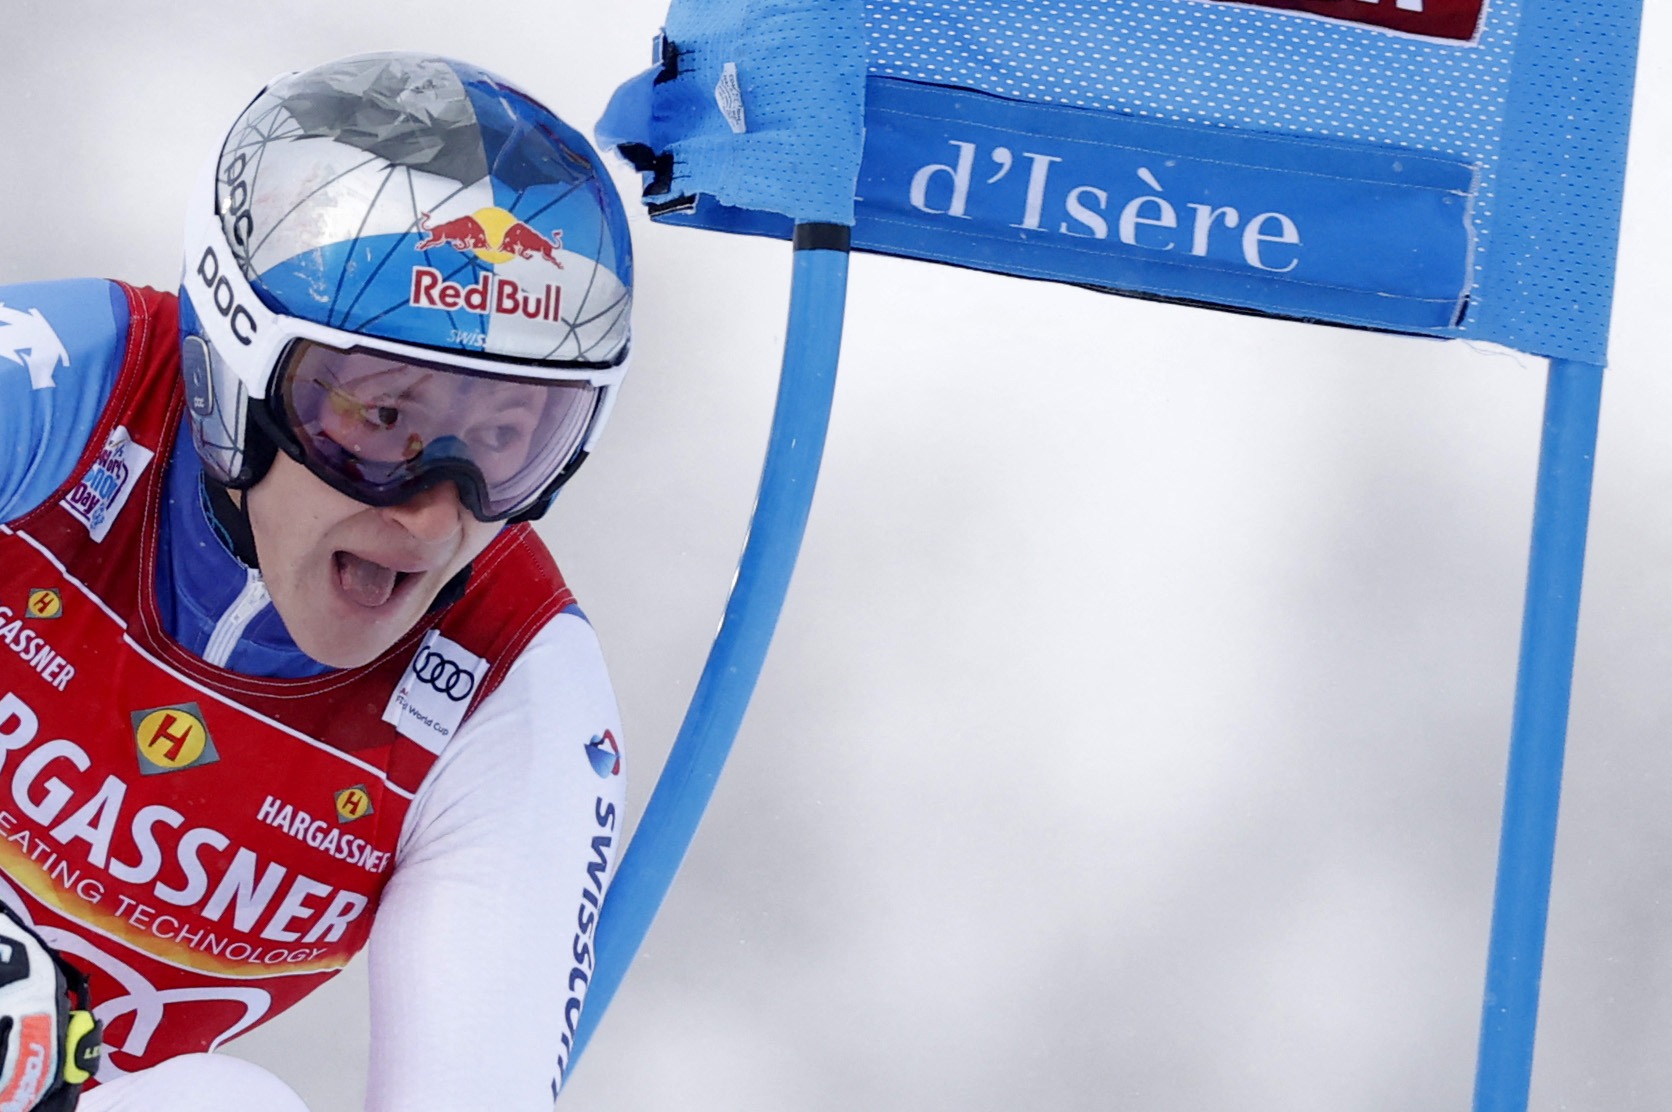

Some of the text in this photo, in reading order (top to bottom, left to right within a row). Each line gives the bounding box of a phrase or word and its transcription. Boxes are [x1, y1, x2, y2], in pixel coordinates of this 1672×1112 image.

[908, 139, 1303, 273] d'Isère
[411, 268, 562, 323] Red Bull
[113, 895, 330, 965] TECHNOLOGY
